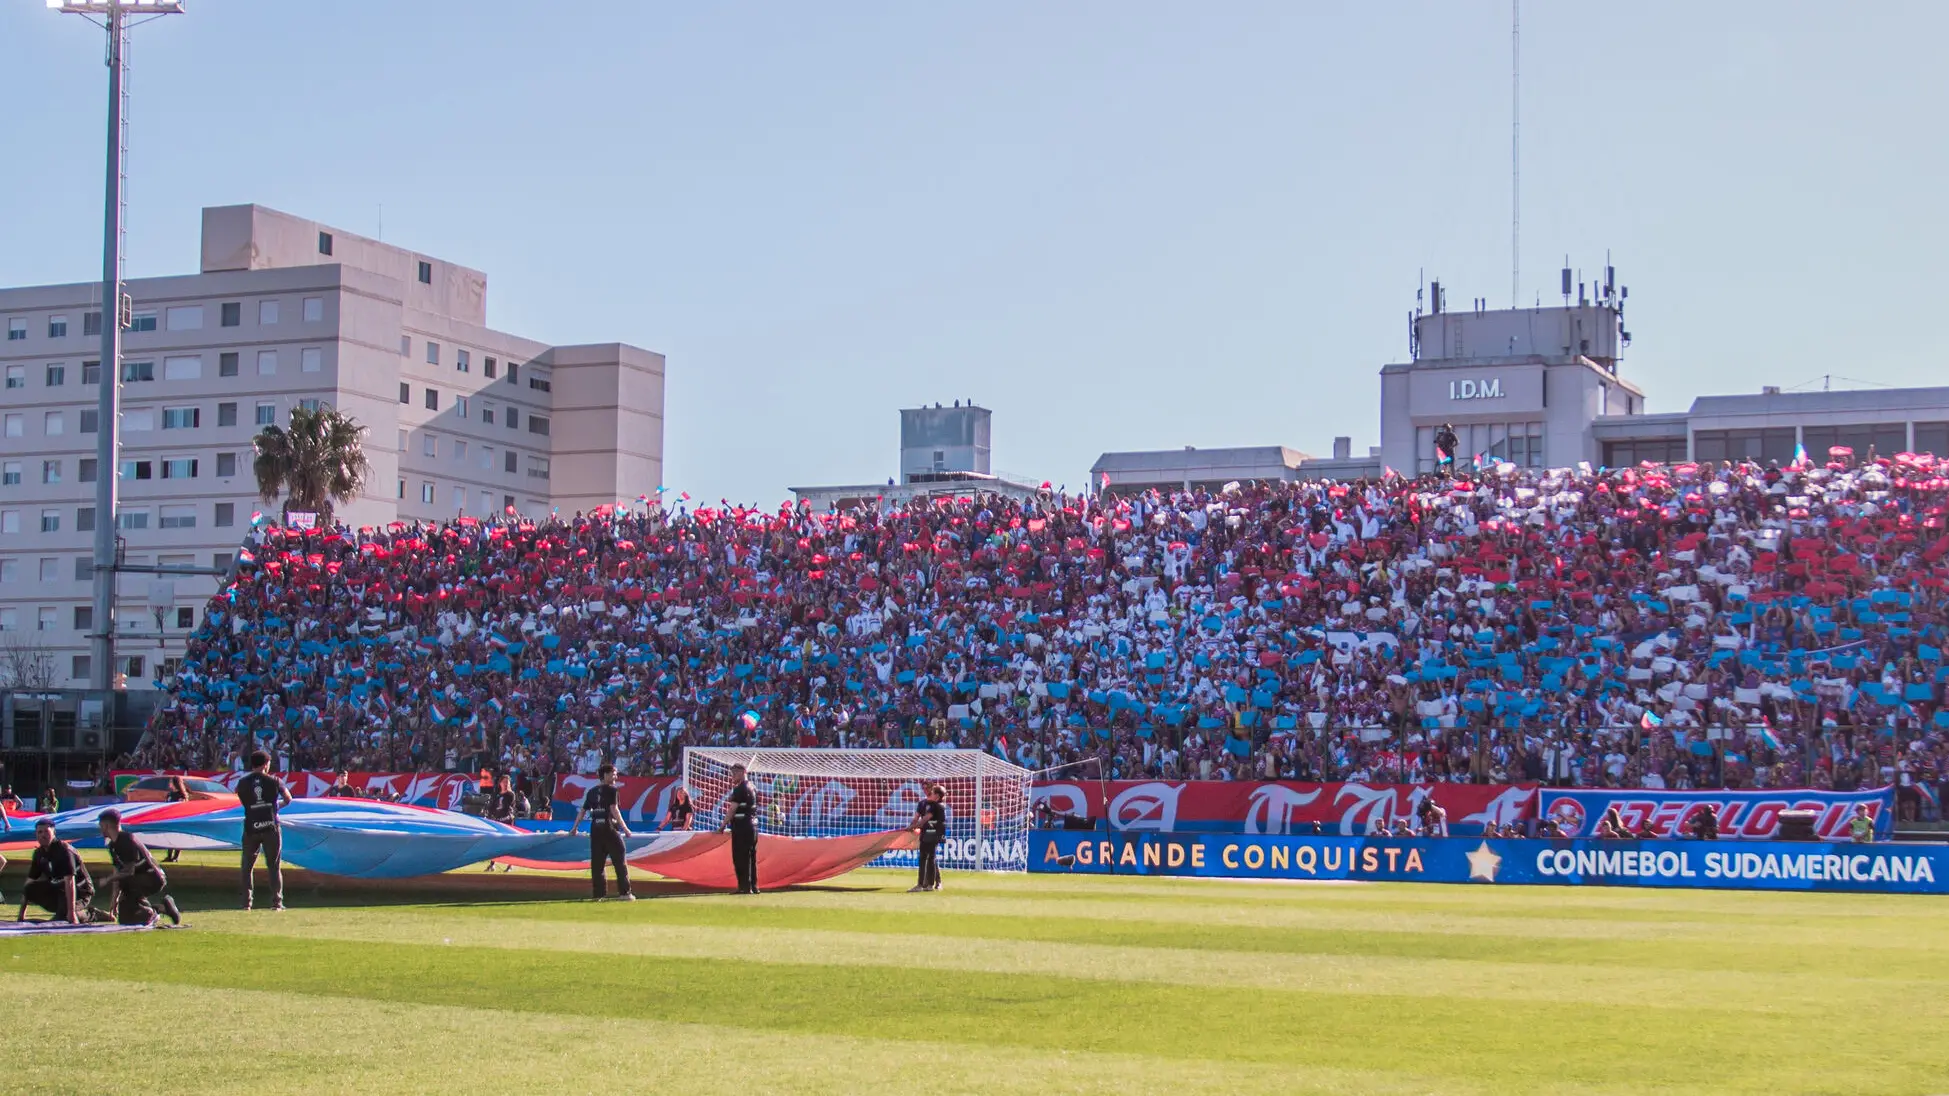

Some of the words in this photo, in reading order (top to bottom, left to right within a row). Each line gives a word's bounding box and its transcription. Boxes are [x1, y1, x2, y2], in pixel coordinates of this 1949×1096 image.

[1450, 379, 1505, 400] I.D.M.
[1044, 840, 1060, 864] A
[1076, 841, 1207, 868] GRANDE
[1221, 843, 1425, 874] CONQUISTA
[1536, 849, 1697, 878] CONMEBOL
[1704, 852, 1936, 883] SUDAMERICANA
